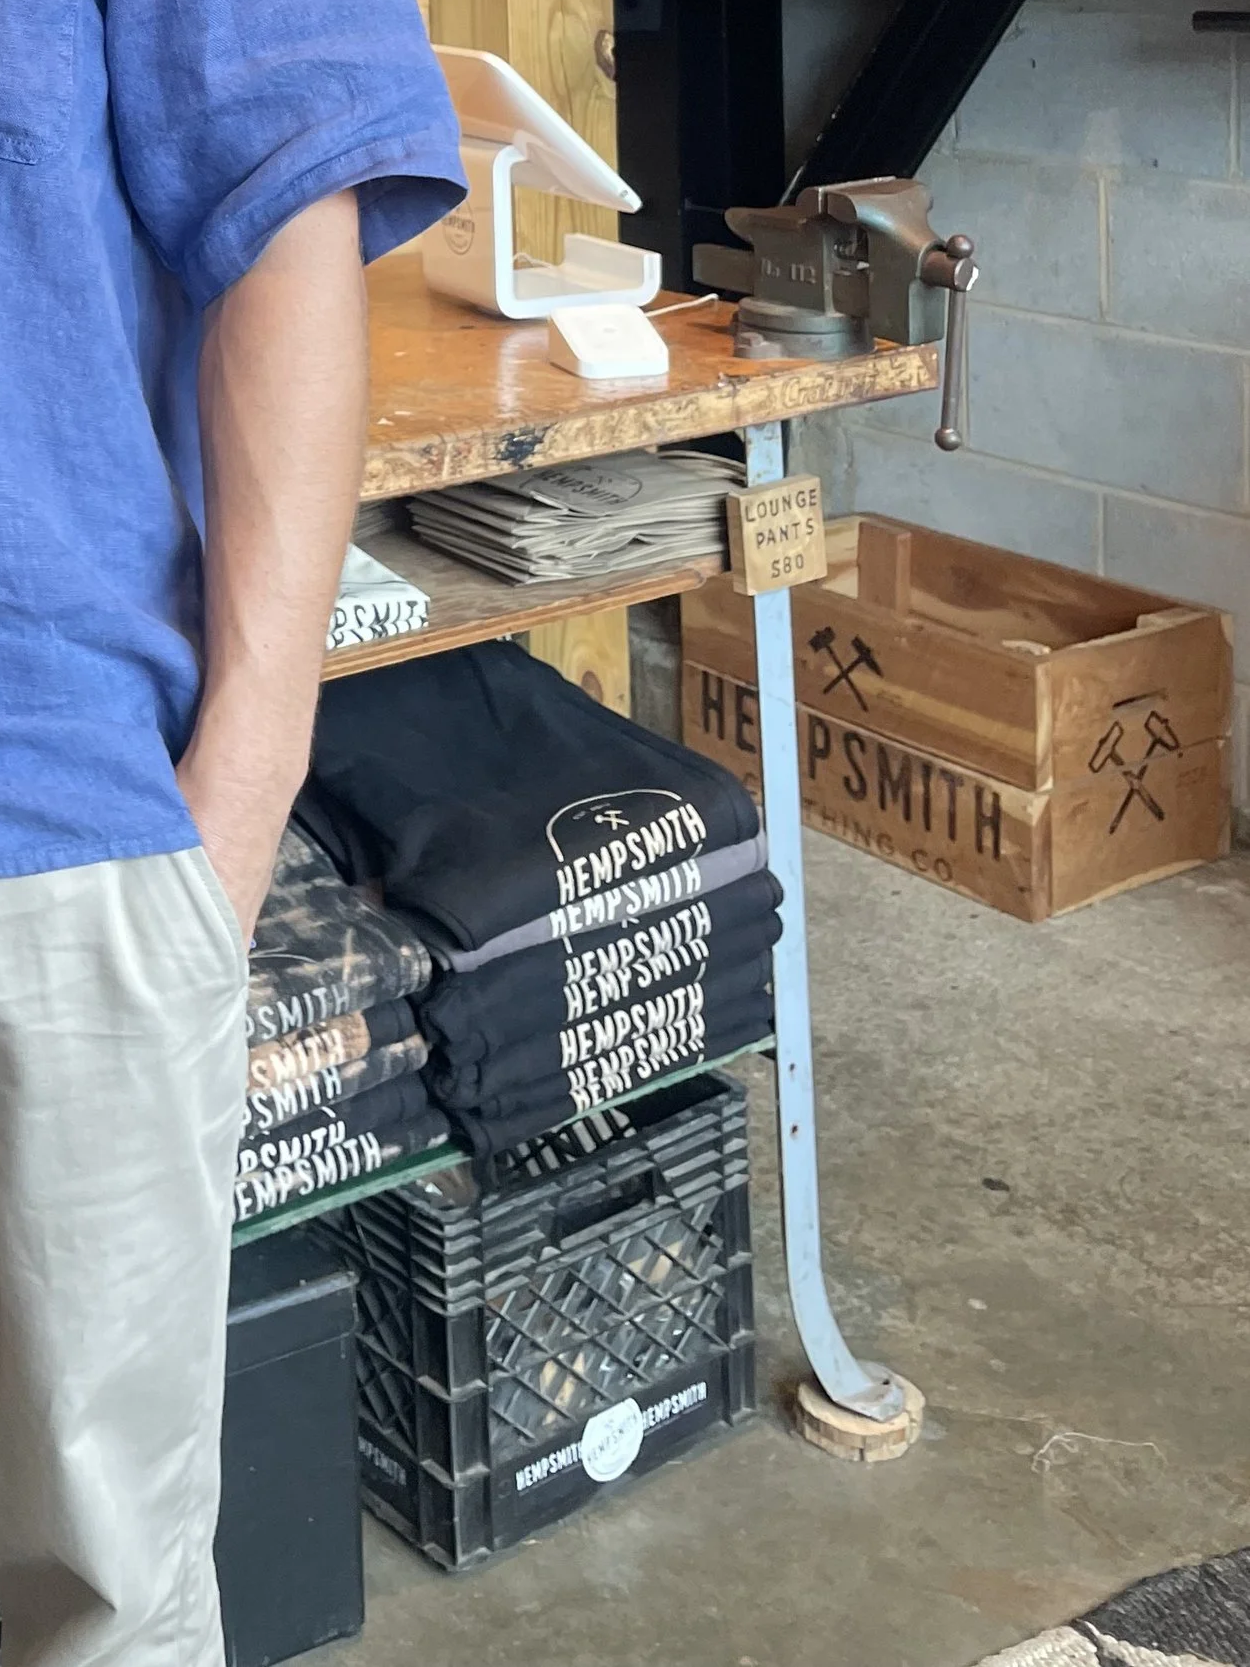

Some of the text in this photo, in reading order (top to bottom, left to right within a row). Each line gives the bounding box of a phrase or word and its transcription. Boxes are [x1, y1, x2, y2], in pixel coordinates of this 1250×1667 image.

[744, 488, 817, 523] LOUNGE
[755, 517, 815, 550] PANTS
[700, 670, 1002, 862] HEPSMITH
[556, 803, 707, 906] HEMPSMITH
[559, 982, 705, 1069] HEMPSMITH
[232, 1132, 383, 1223] EMPSMITH
